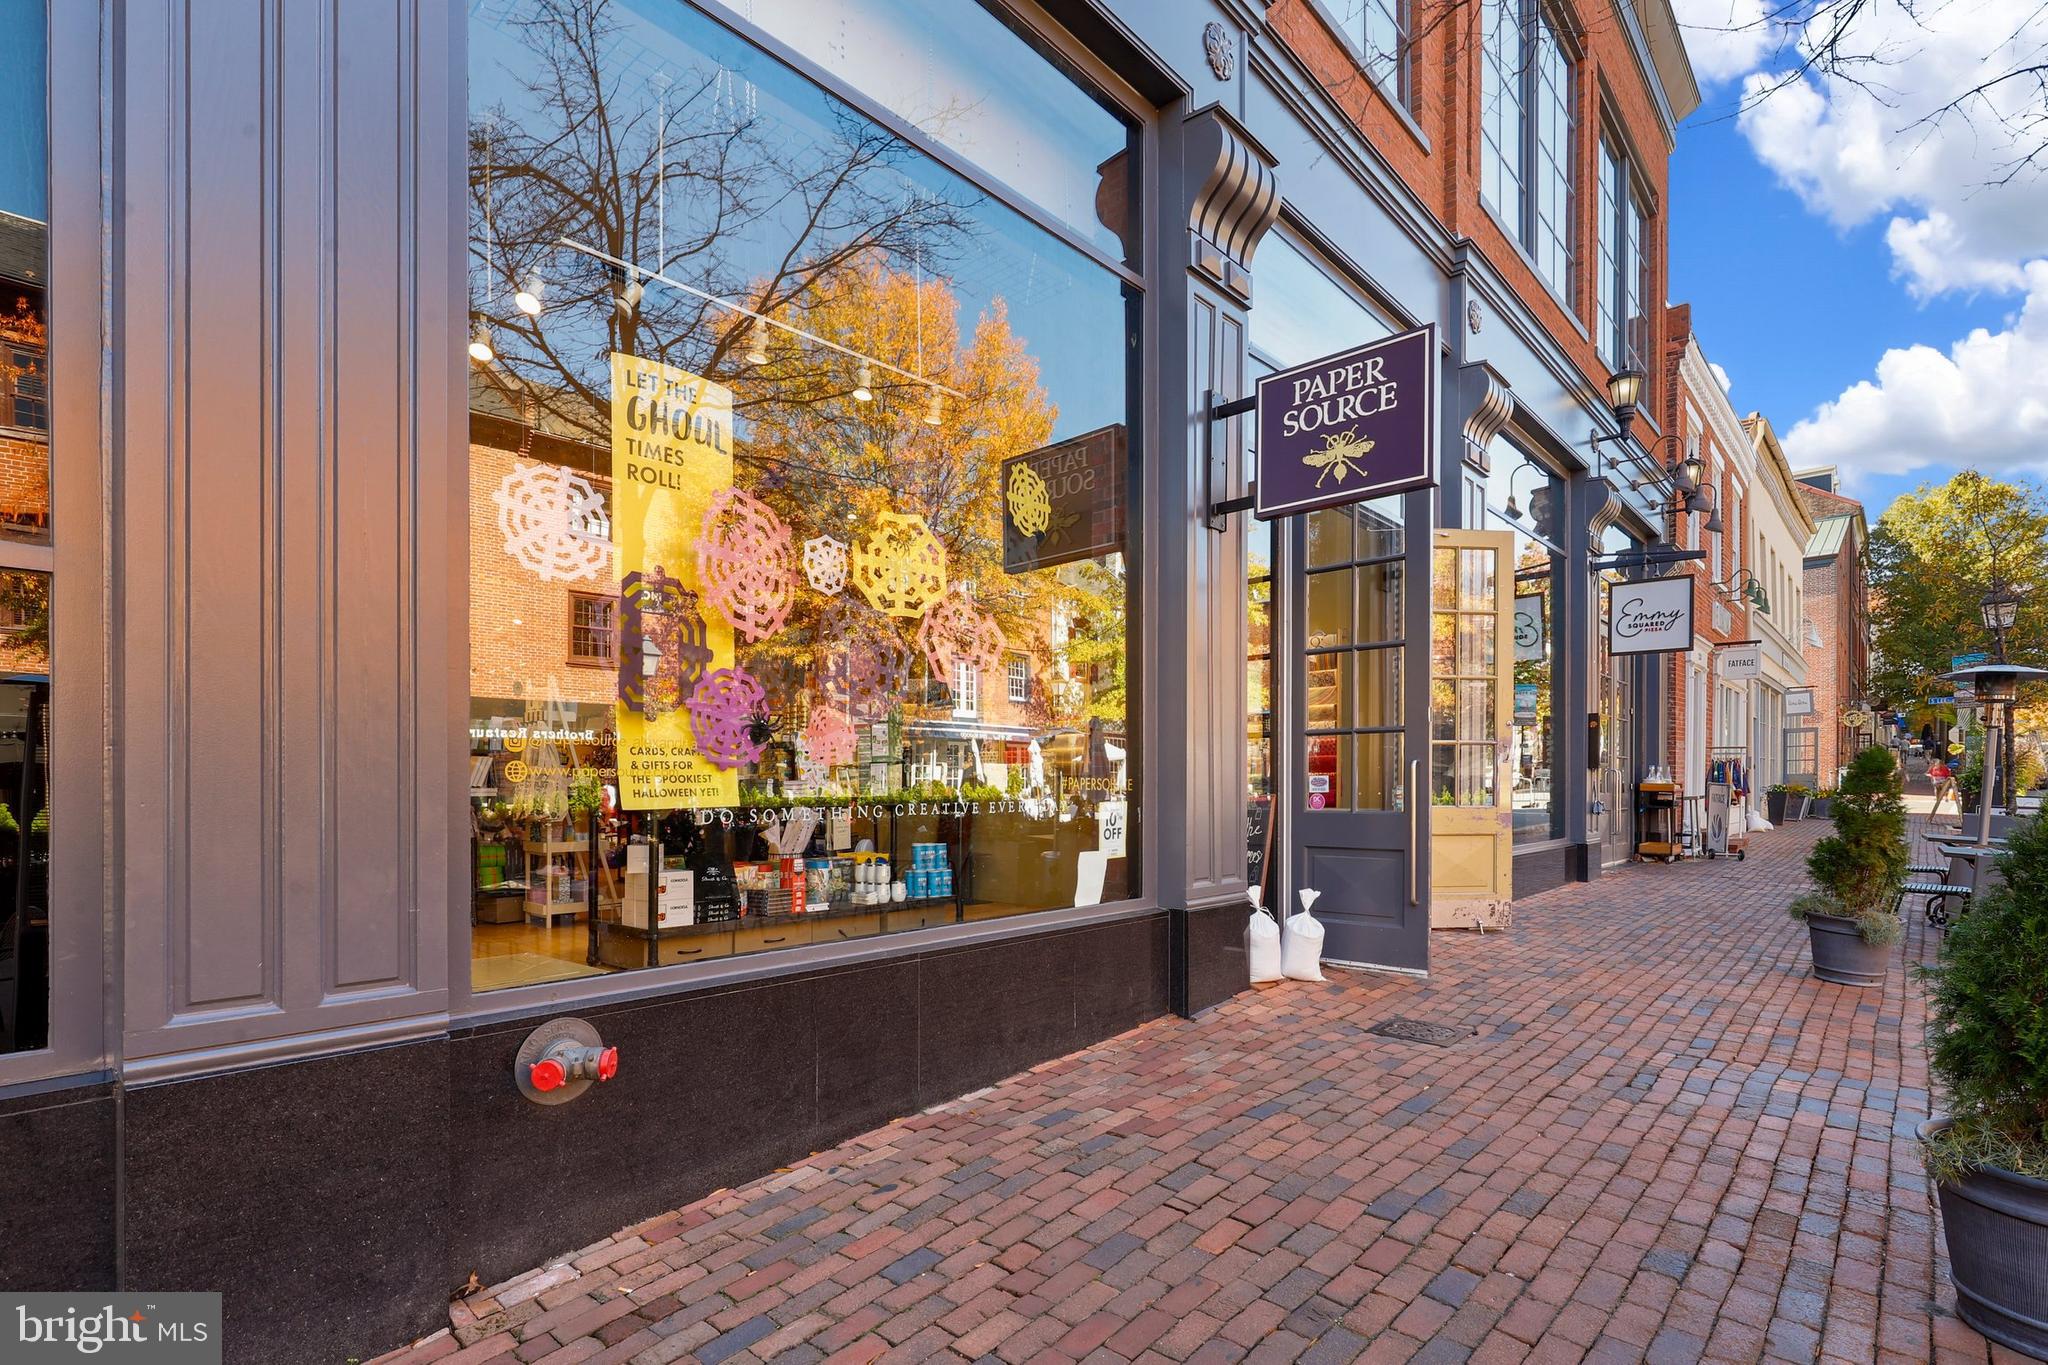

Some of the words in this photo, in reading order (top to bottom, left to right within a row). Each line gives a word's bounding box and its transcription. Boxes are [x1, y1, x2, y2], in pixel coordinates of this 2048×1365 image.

[626, 369, 658, 392] LET
[663, 378, 697, 405] THE
[1292, 356, 1388, 407] PAPER
[1282, 382, 1398, 437] SOURCE
[626, 395, 728, 455] GHOUL
[625, 437, 684, 466] TIMES
[627, 463, 680, 490] ROLL!
[1616, 597, 1685, 638] Emmy
[1628, 620, 1665, 629] SQUARED
[1727, 658, 1756, 668] FATFACE
[630, 746, 668, 758] CARDS,
[670, 747, 706, 757] CRAF
[630, 760, 639, 770] &
[641, 760, 671, 770] GIFTS
[673, 760, 693, 770] FOR
[632, 774, 651, 784] THE
[633, 788, 697, 799] HALLOWEEN
[699, 787, 720, 797] YET!
[700, 809, 734, 825] DO
[749, 804, 884, 823] SOMETHING
[895, 802, 980, 817] CREATIVE
[989, 800, 1037, 814] EVER
[1103, 828, 1122, 840] OFF
